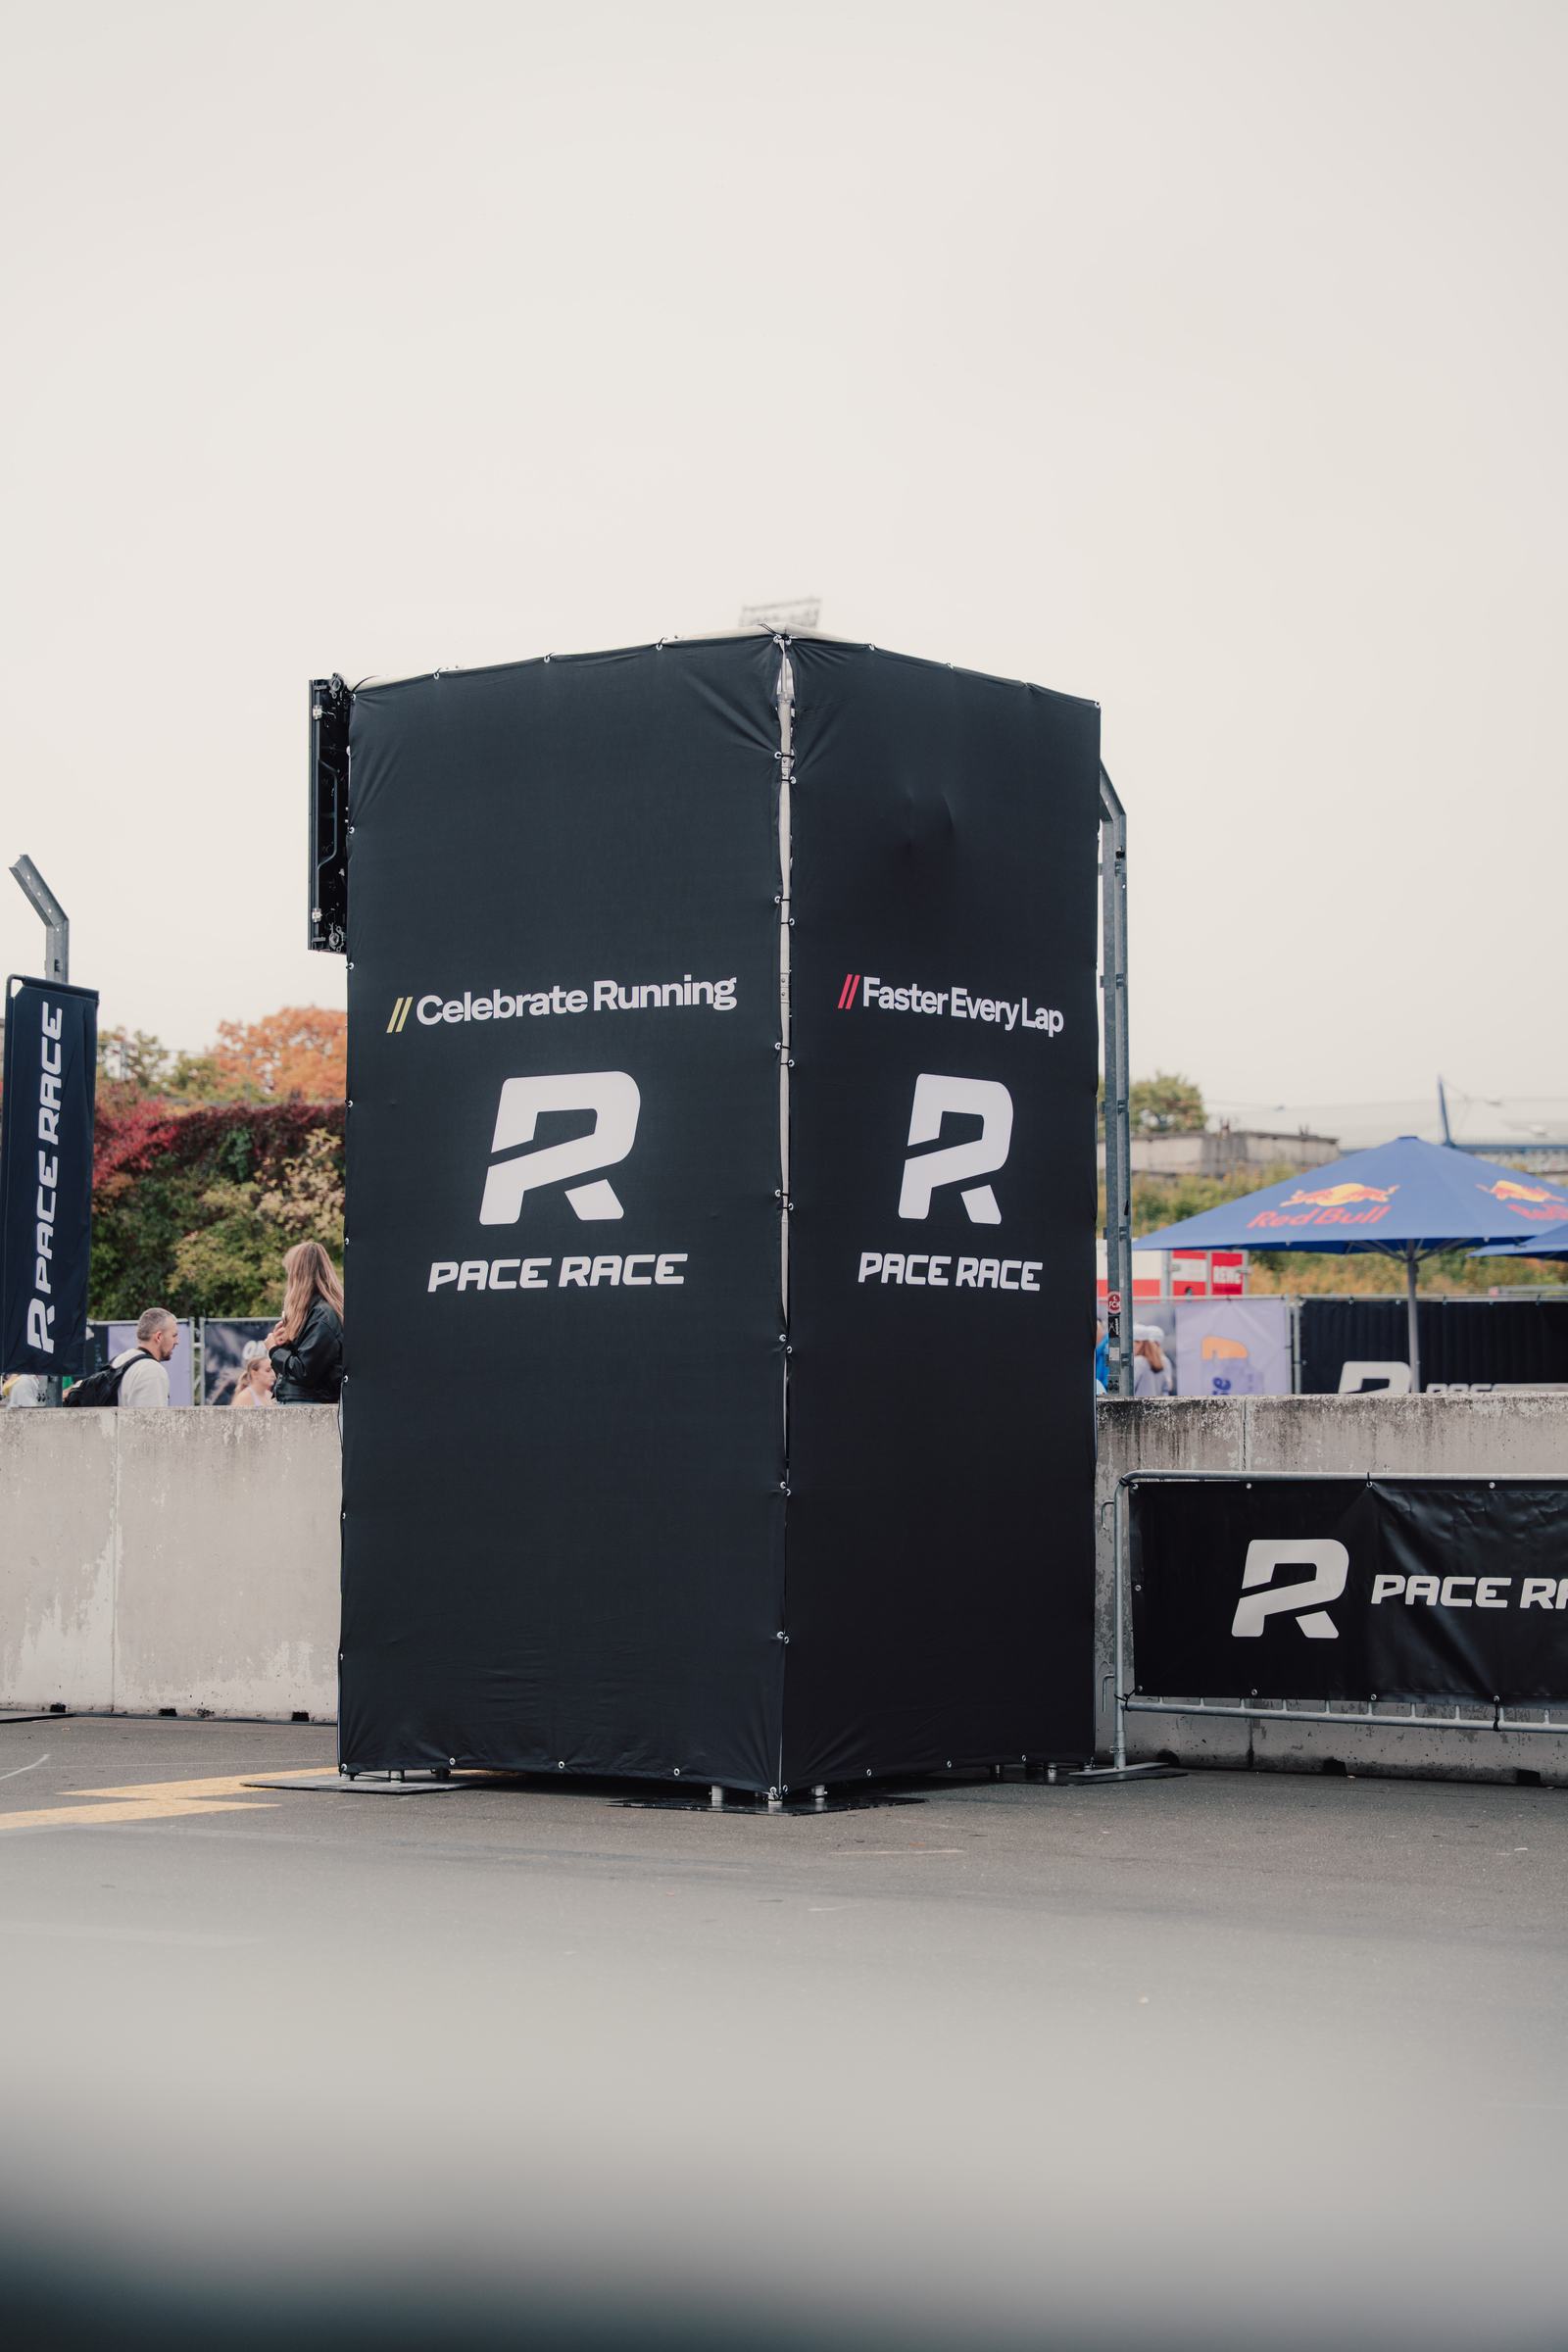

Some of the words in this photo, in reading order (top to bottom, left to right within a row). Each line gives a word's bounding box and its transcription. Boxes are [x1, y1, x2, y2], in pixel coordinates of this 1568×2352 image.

[416, 985, 588, 1026] Celebrate
[593, 974, 737, 1011] Running
[863, 976, 948, 1015] Faster
[951, 987, 1019, 1031] Every
[1022, 998, 1063, 1038] Lap
[38, 1001, 63, 1146] RACE
[35, 1150, 59, 1295] PACE
[1247, 1207, 1320, 1229] Red
[1313, 1204, 1393, 1224] Bull
[427, 1257, 552, 1293] PACE
[559, 1253, 689, 1288] RACE
[858, 1252, 952, 1286] PACE
[956, 1257, 1044, 1292] RACE
[1371, 1574, 1512, 1608] PACE
